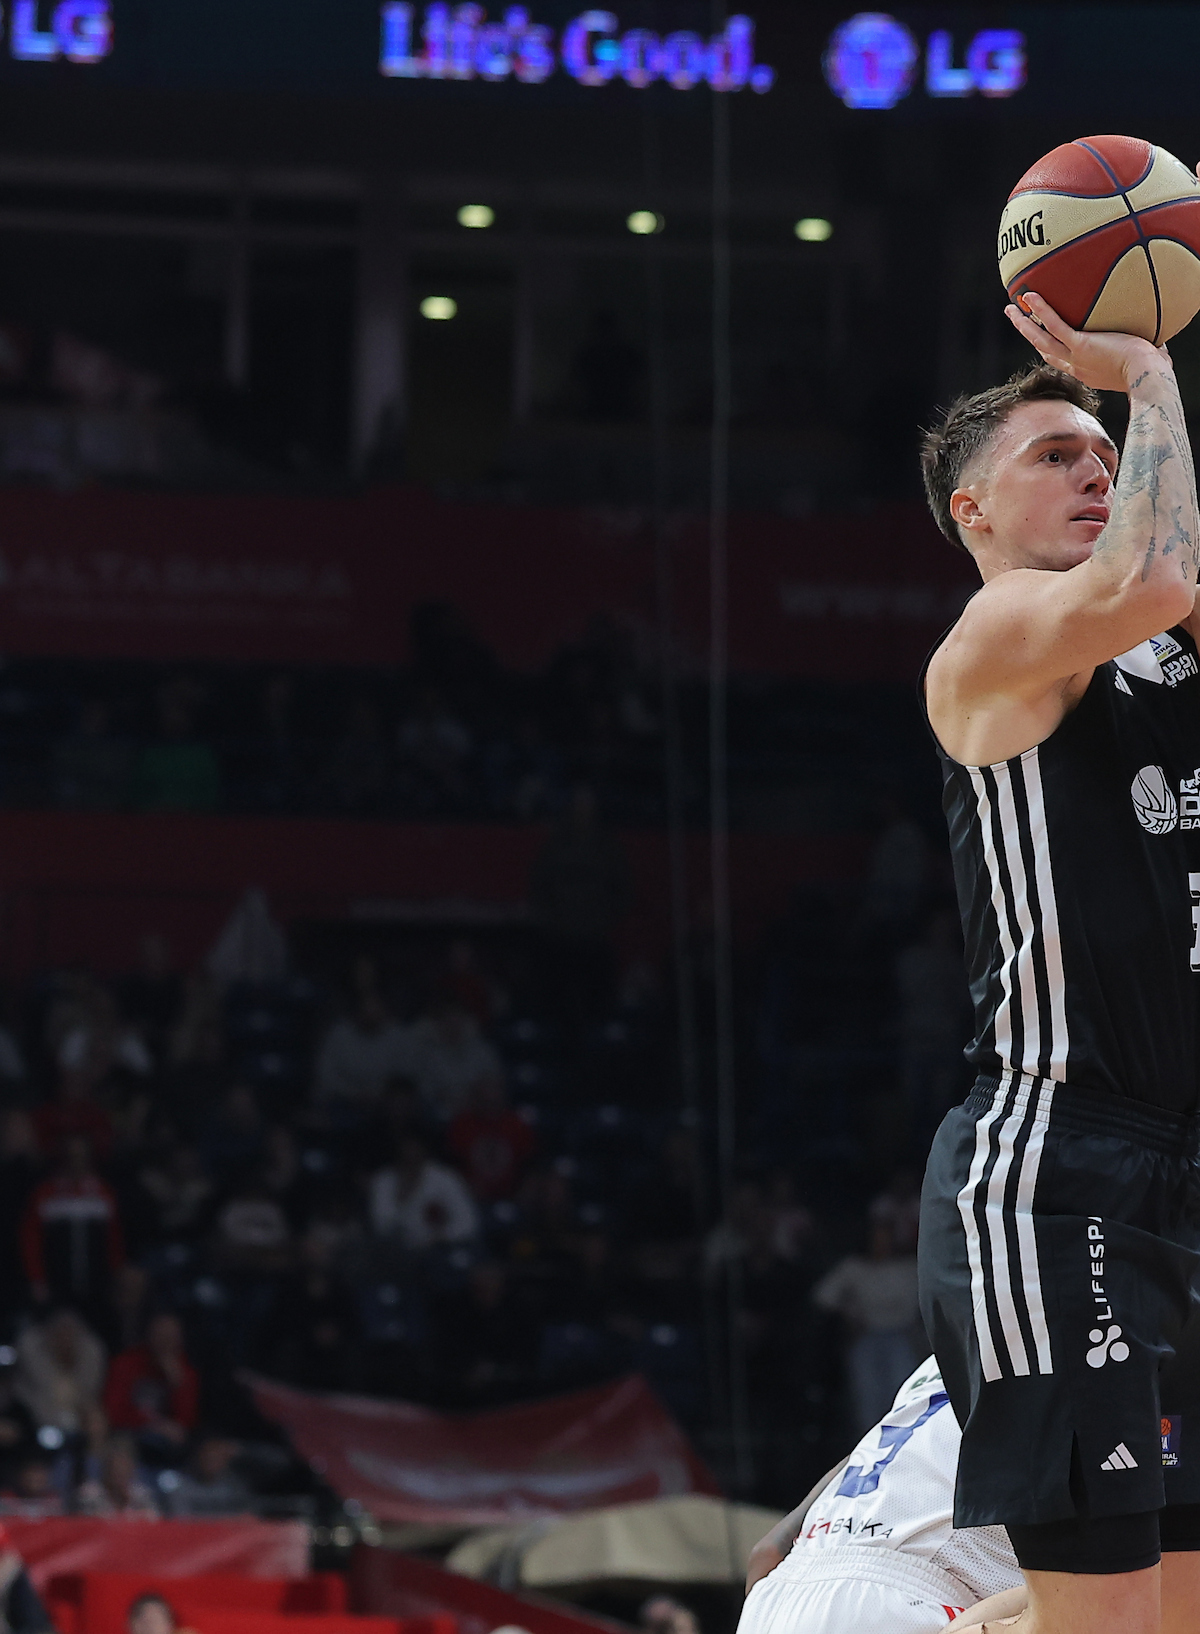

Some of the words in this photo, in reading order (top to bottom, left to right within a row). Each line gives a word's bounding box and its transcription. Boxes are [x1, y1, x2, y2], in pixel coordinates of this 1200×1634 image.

[9, 0, 114, 64] LG
[380, 2, 554, 83] Life's
[562, 10, 777, 93] Good.
[926, 29, 1027, 98] LG
